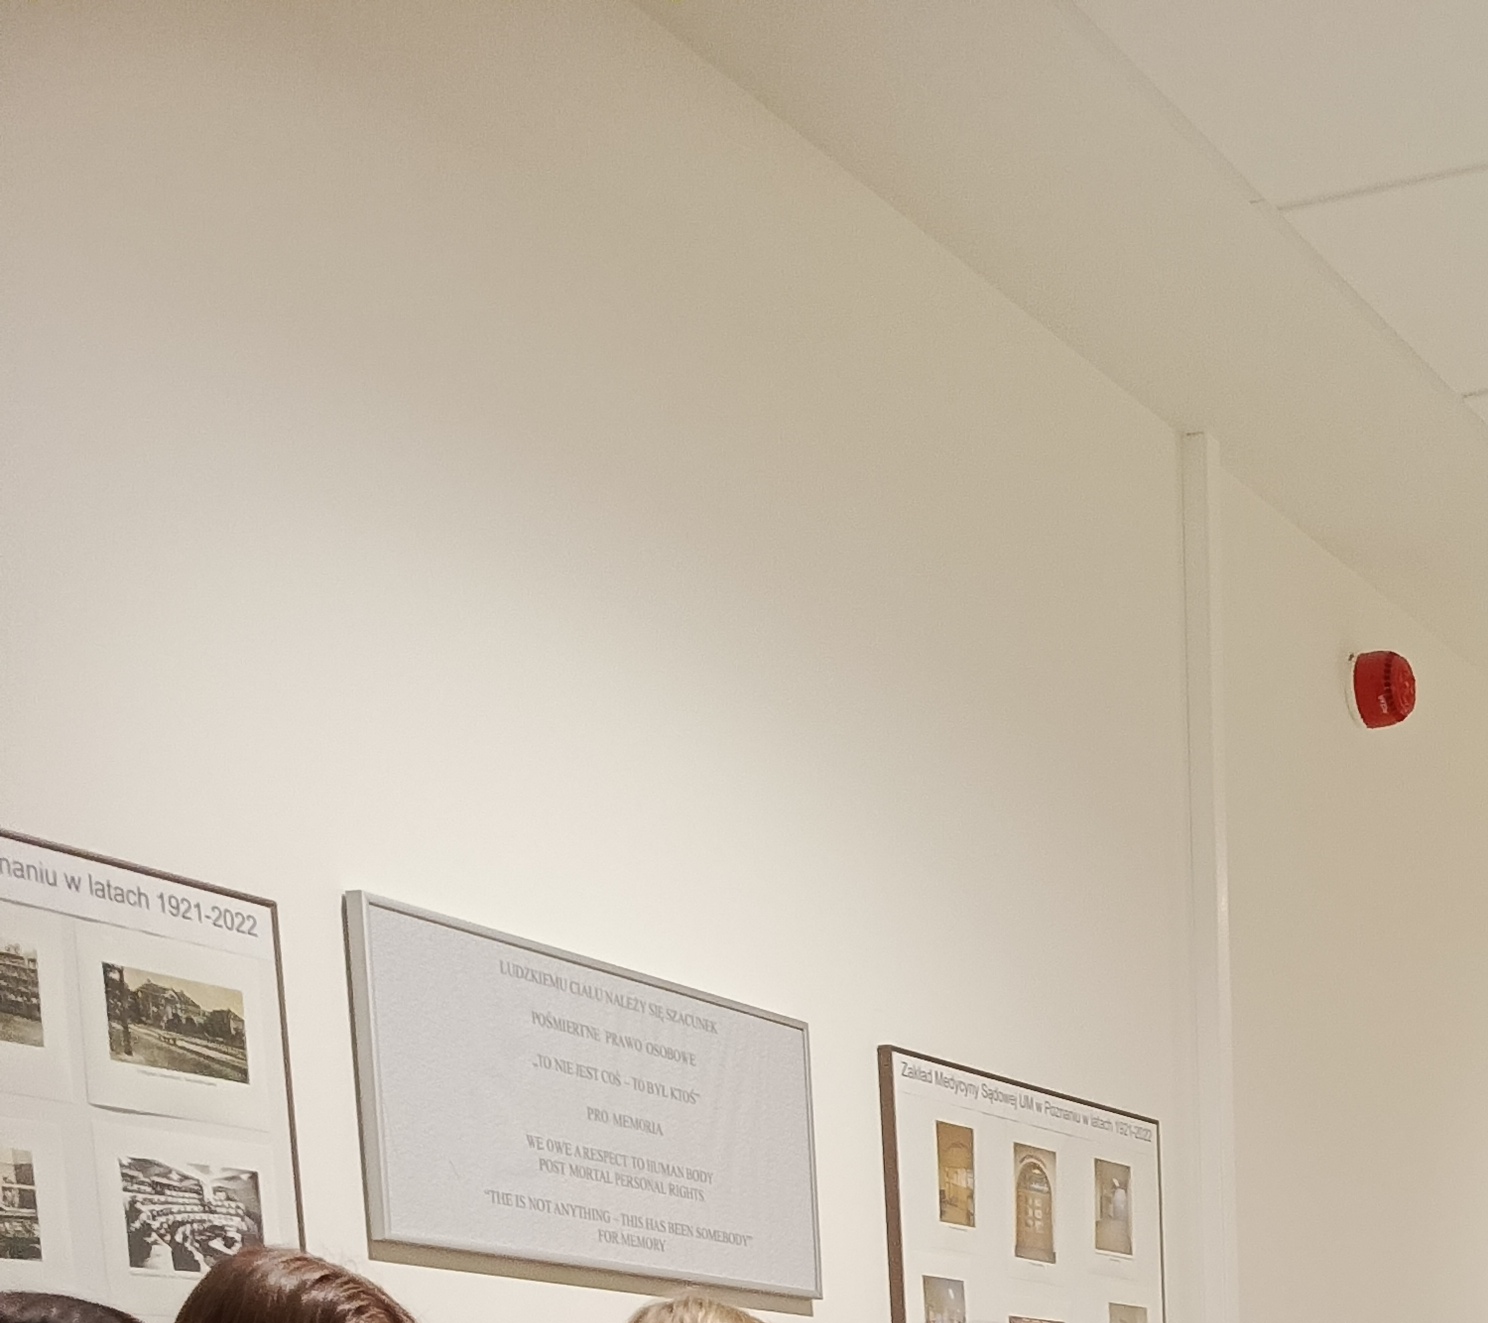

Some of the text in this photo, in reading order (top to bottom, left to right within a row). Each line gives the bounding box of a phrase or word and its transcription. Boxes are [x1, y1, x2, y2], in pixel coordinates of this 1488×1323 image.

[63, 872, 82, 893] w
[88, 873, 150, 911] latach
[157, 891, 259, 938] 1921-2022
[499, 960, 568, 992] LUDZKIEMU
[666, 1008, 718, 1035] SZACUNEK
[531, 1010, 697, 1067] POŚMIERTNE PRAWO OSOBOWE
[554, 1058, 574, 1075] NIE
[575, 1063, 600, 1081] JEST
[632, 1076, 646, 1092] TO
[586, 1106, 664, 1136] PRO MEMORIA
[526, 1134, 545, 1151] WE
[546, 1138, 573, 1156] OWE
[583, 1146, 628, 1168] RESPECT
[631, 1156, 646, 1171] TO
[646, 1159, 685, 1179] HUMAN
[685, 1167, 714, 1185] BODY
[538, 1157, 705, 1202] POST MORTAL PERSONAL RIGHTS
[515, 1194, 526, 1209] IS
[528, 1195, 553, 1214] NOT
[553, 1202, 611, 1224] ANYTHING
[620, 1212, 644, 1229] THIS
[645, 1217, 667, 1234] HAS
[667, 1222, 694, 1238] BEEN
[598, 1228, 666, 1252] FOR MEMORY
